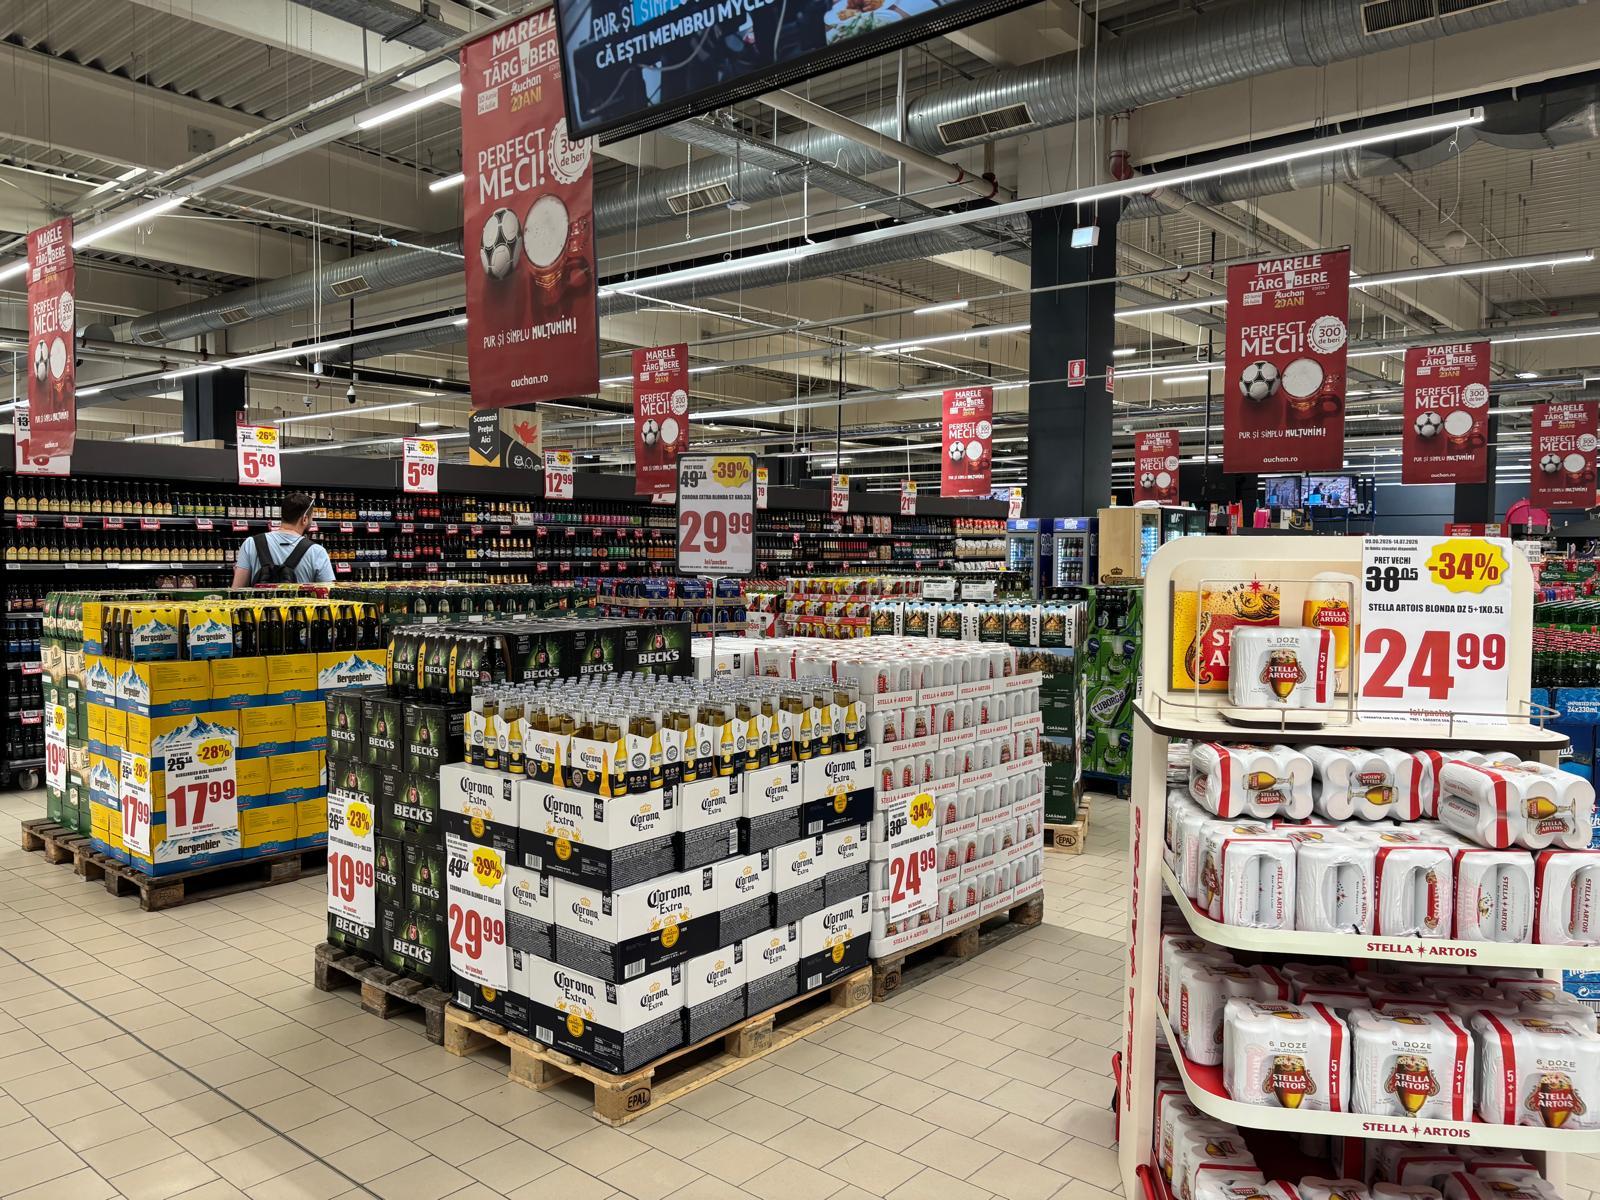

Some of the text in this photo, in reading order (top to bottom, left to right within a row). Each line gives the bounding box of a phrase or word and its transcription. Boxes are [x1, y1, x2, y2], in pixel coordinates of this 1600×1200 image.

[592, 12, 618, 41] PUR
[595, 6, 715, 69] CĂ EȘTI MEMBRU
[483, 55, 519, 88] TÂRG
[510, 74, 542, 96] Auchan
[478, 127, 546, 173] PERFECT
[560, 149, 586, 167] de beri
[479, 150, 545, 205] MECI!
[36, 225, 63, 249] MARELE
[51, 244, 67, 261] BERE
[1257, 254, 1323, 275] MARELE
[1248, 271, 1329, 292] TÂRG BERE
[1274, 290, 1305, 299] Auchan
[33, 295, 59, 316] PERFECT
[33, 309, 59, 337] MECI!
[1241, 320, 1306, 339] PERFECT
[1319, 327, 1341, 338] 300
[483, 335, 496, 349] PUR
[1241, 333, 1305, 358] MECI!
[1318, 336, 1341, 345] de beri
[645, 347, 676, 361] MARELE
[1427, 343, 1473, 356] MARELE
[642, 359, 680, 373] TÂRG BERE
[1420, 354, 1477, 367] TÂRG BERE
[510, 374, 549, 389] auchan.ro
[640, 391, 671, 405] PERFECT
[955, 389, 982, 399] MARELE
[1415, 385, 1461, 396] PERFECT
[1469, 389, 1485, 397] 300
[640, 400, 671, 417] MECI!
[1415, 393, 1461, 410] MECI!
[1548, 403, 1585, 413] MARELE
[473, 412, 498, 424] Scanează
[1570, 411, 1588, 420] BERE
[948, 421, 976, 431] PERFECT
[948, 427, 976, 440] MECI!
[256, 430, 276, 441] -26%
[480, 435, 492, 444] Aici
[1238, 431, 1251, 440] PUR
[1539, 434, 1577, 444] PERFECT
[1539, 441, 1576, 452] MECI!
[243, 451, 276, 479] 5 49
[1263, 456, 1299, 464] auchan.ro
[407, 461, 435, 487] 5 89
[680, 461, 749, 488] 49 -39%
[1430, 471, 1456, 479] auchan.ro
[546, 472, 574, 493] 12 99
[679, 509, 753, 554] 29 99
[1374, 556, 1411, 565] PRET VECHI
[1365, 552, 1499, 593] 38 -34%
[1222, 583, 1246, 601] ANNO
[1368, 603, 1505, 615] STELLA ARTOIS BLONDA DZ 5+1X0.5L
[140, 632, 173, 644] Bergenbier
[196, 632, 227, 644] Bergenbier
[638, 650, 680, 665] BECK'S
[1362, 628, 1507, 700] 24 99
[393, 662, 415, 672] BECK'S
[425, 665, 448, 675] BECK'S
[523, 667, 561, 680] BECK'S
[336, 672, 373, 686] Bergenbier
[1267, 672, 1299, 680] ARTOIS
[922, 692, 936, 700] STELLA
[960, 687, 974, 695] STELLA
[877, 696, 913, 706] STELLA ARTOIS
[331, 728, 356, 742] BECK'S
[369, 736, 395, 750] BECK'S
[197, 743, 230, 761] -28%
[410, 744, 439, 758] BECK'S
[825, 760, 857, 778] Corona
[832, 774, 850, 784] Extra
[460, 776, 494, 798] Corona
[166, 779, 236, 828] 17 99
[467, 791, 487, 807] Extra
[543, 793, 583, 819] Corona
[701, 795, 728, 810] Corona
[121, 794, 150, 838] 17 99
[393, 803, 433, 824] BECK'S
[553, 811, 575, 828] Extra
[630, 809, 660, 827] Corona
[909, 802, 932, 822] -34%
[346, 809, 371, 832] -23%
[637, 822, 655, 832] Extra
[177, 838, 221, 855] Bergenbier
[1057, 836, 1073, 845] EPAL
[474, 855, 502, 880] -39%
[889, 846, 937, 904] 24 99
[328, 851, 374, 903] 19 99
[648, 884, 693, 909] Corona
[1275, 865, 1284, 920] STELLA ARTOIS
[657, 901, 683, 915] Extra
[1501, 876, 1510, 932] STELLA ARTOIS
[823, 908, 855, 930] Corona
[335, 916, 371, 940] BECK'S
[449, 903, 505, 960] 29 99
[831, 923, 848, 935] Extra
[1367, 942, 1478, 959] STELLA ARTOIS
[554, 970, 597, 999] Corona
[562, 987, 588, 1006] Extra
[1269, 1040, 1308, 1049] 6 DOZE
[1403, 1041, 1433, 1050] DOZE
[1272, 1073, 1306, 1083] STELLA
[1272, 1081, 1307, 1090] ARTOIS
[1394, 1073, 1430, 1083] STELLA
[1394, 1080, 1430, 1091] ARTOIS
[627, 1091, 648, 1109] EPAL
[1537, 1092, 1573, 1101] STELLA
[1537, 1099, 1574, 1108] ARTOIS
[1362, 1121, 1471, 1139] STELLA ARTOIS
